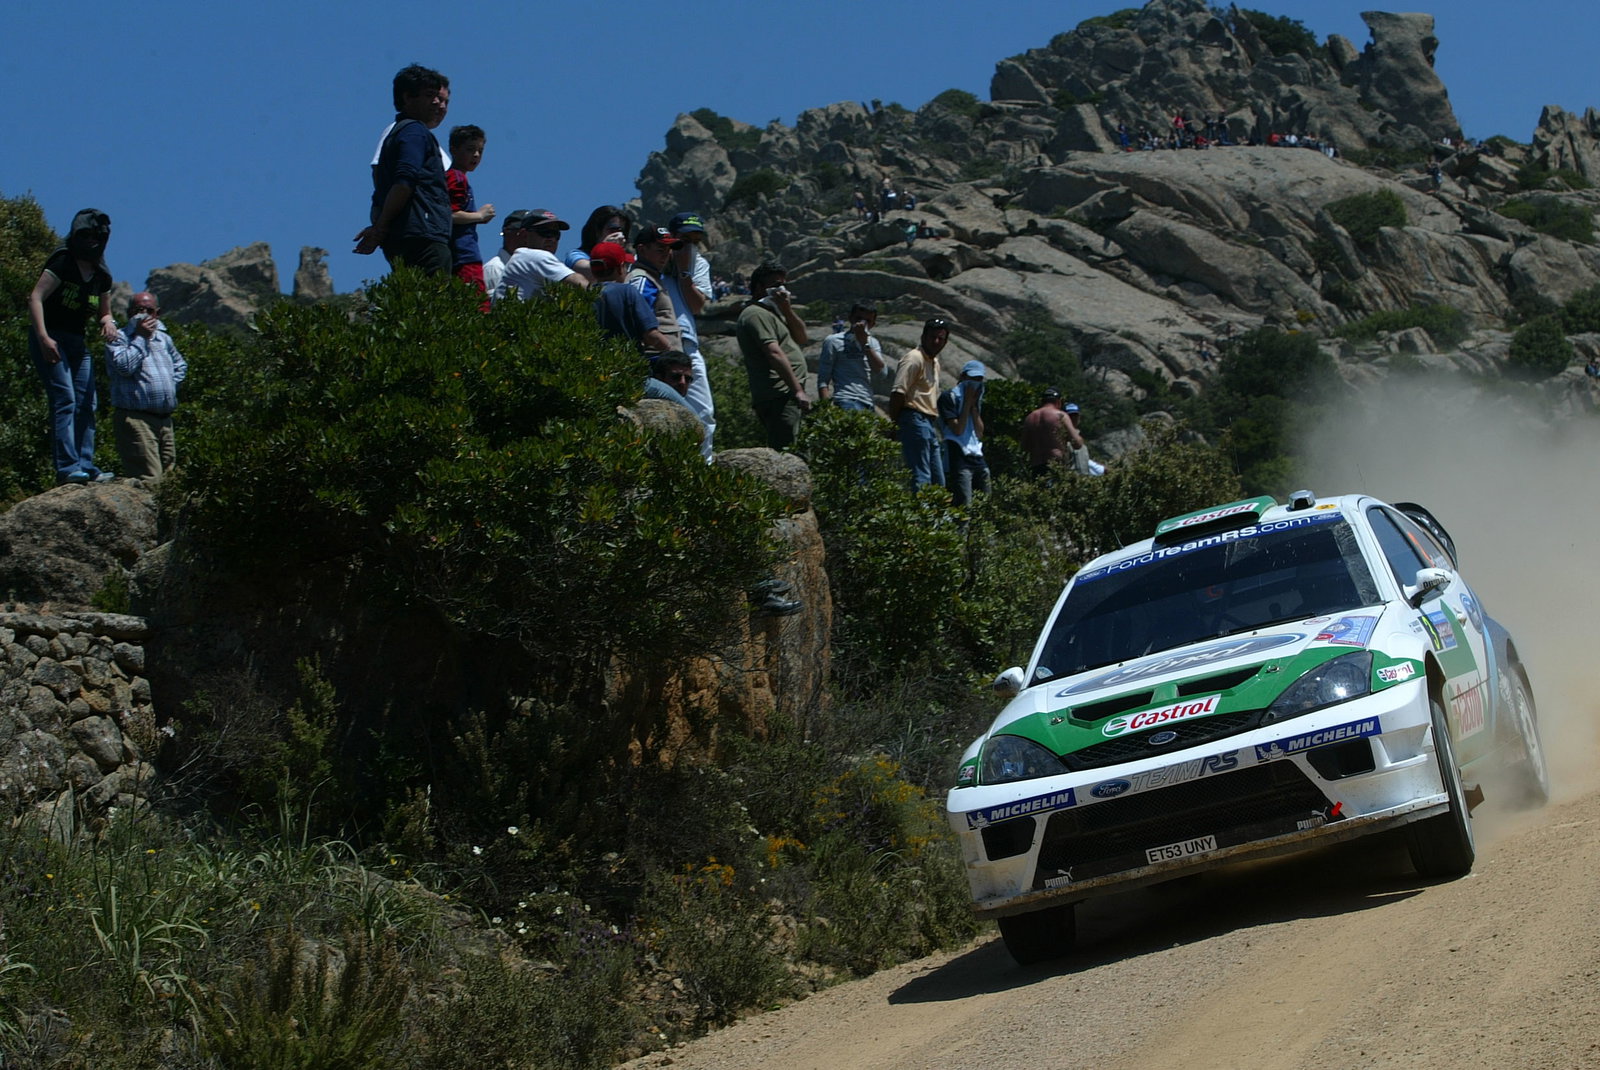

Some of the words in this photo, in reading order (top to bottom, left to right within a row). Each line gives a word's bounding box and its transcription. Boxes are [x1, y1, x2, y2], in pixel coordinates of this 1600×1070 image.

[1182, 504, 1254, 526] Castrol
[1107, 517, 1311, 574] FordTeamRS.com
[1103, 640, 1256, 685] Ford
[1131, 698, 1213, 729] Castrol
[1288, 721, 1374, 751] MICHELIN
[1098, 783, 1123, 796] Ford
[991, 793, 1069, 820] MICHELIN
[1150, 845, 1182, 862] ET53
[1184, 837, 1213, 854] UNY
